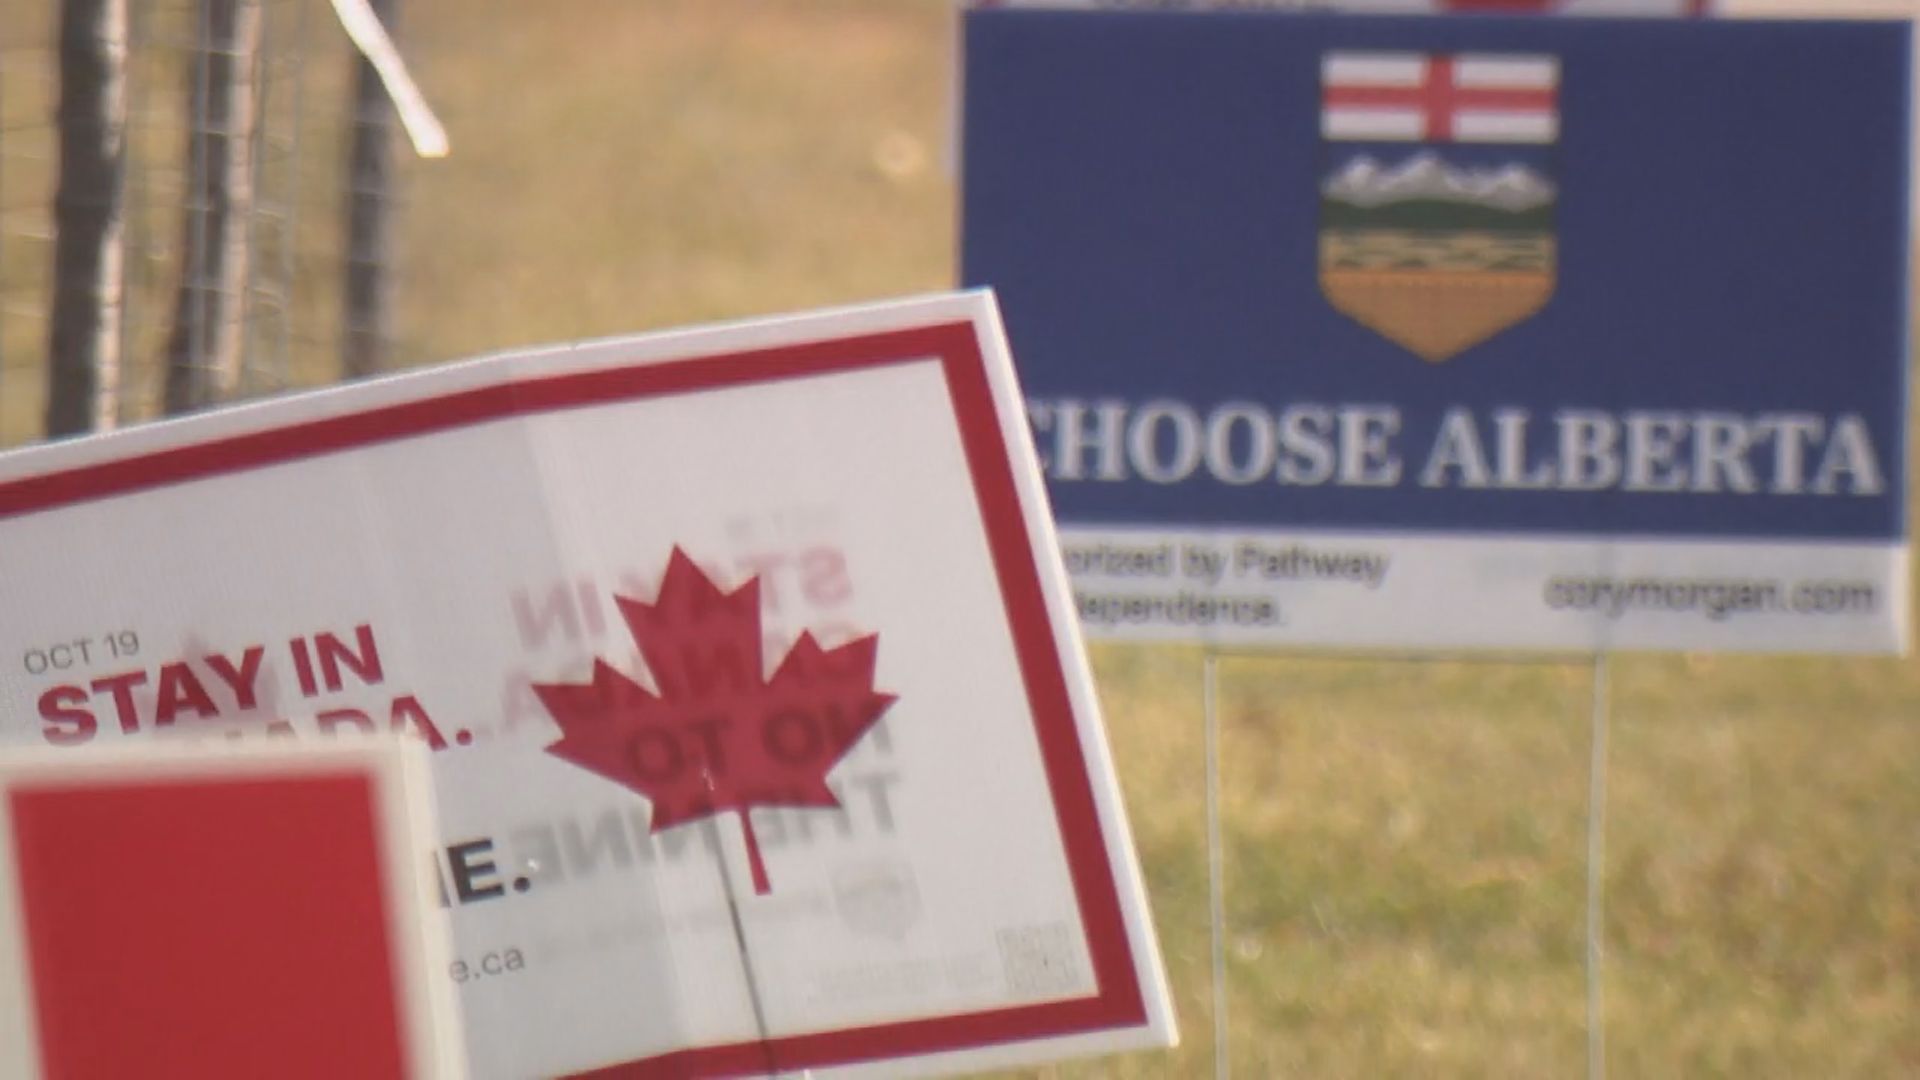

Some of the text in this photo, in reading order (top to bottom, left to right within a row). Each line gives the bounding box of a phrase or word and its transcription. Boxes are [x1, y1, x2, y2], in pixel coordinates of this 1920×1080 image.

[1419, 409, 1885, 497] ALBERTA
[1182, 545, 1229, 586] by
[1235, 547, 1389, 590] Pathway
[1543, 577, 1875, 618] corymorgan.com
[23, 631, 140, 674] OCT 19
[37, 646, 265, 746] STAY
[289, 624, 384, 698] IN
[433, 838, 531, 908] E.
